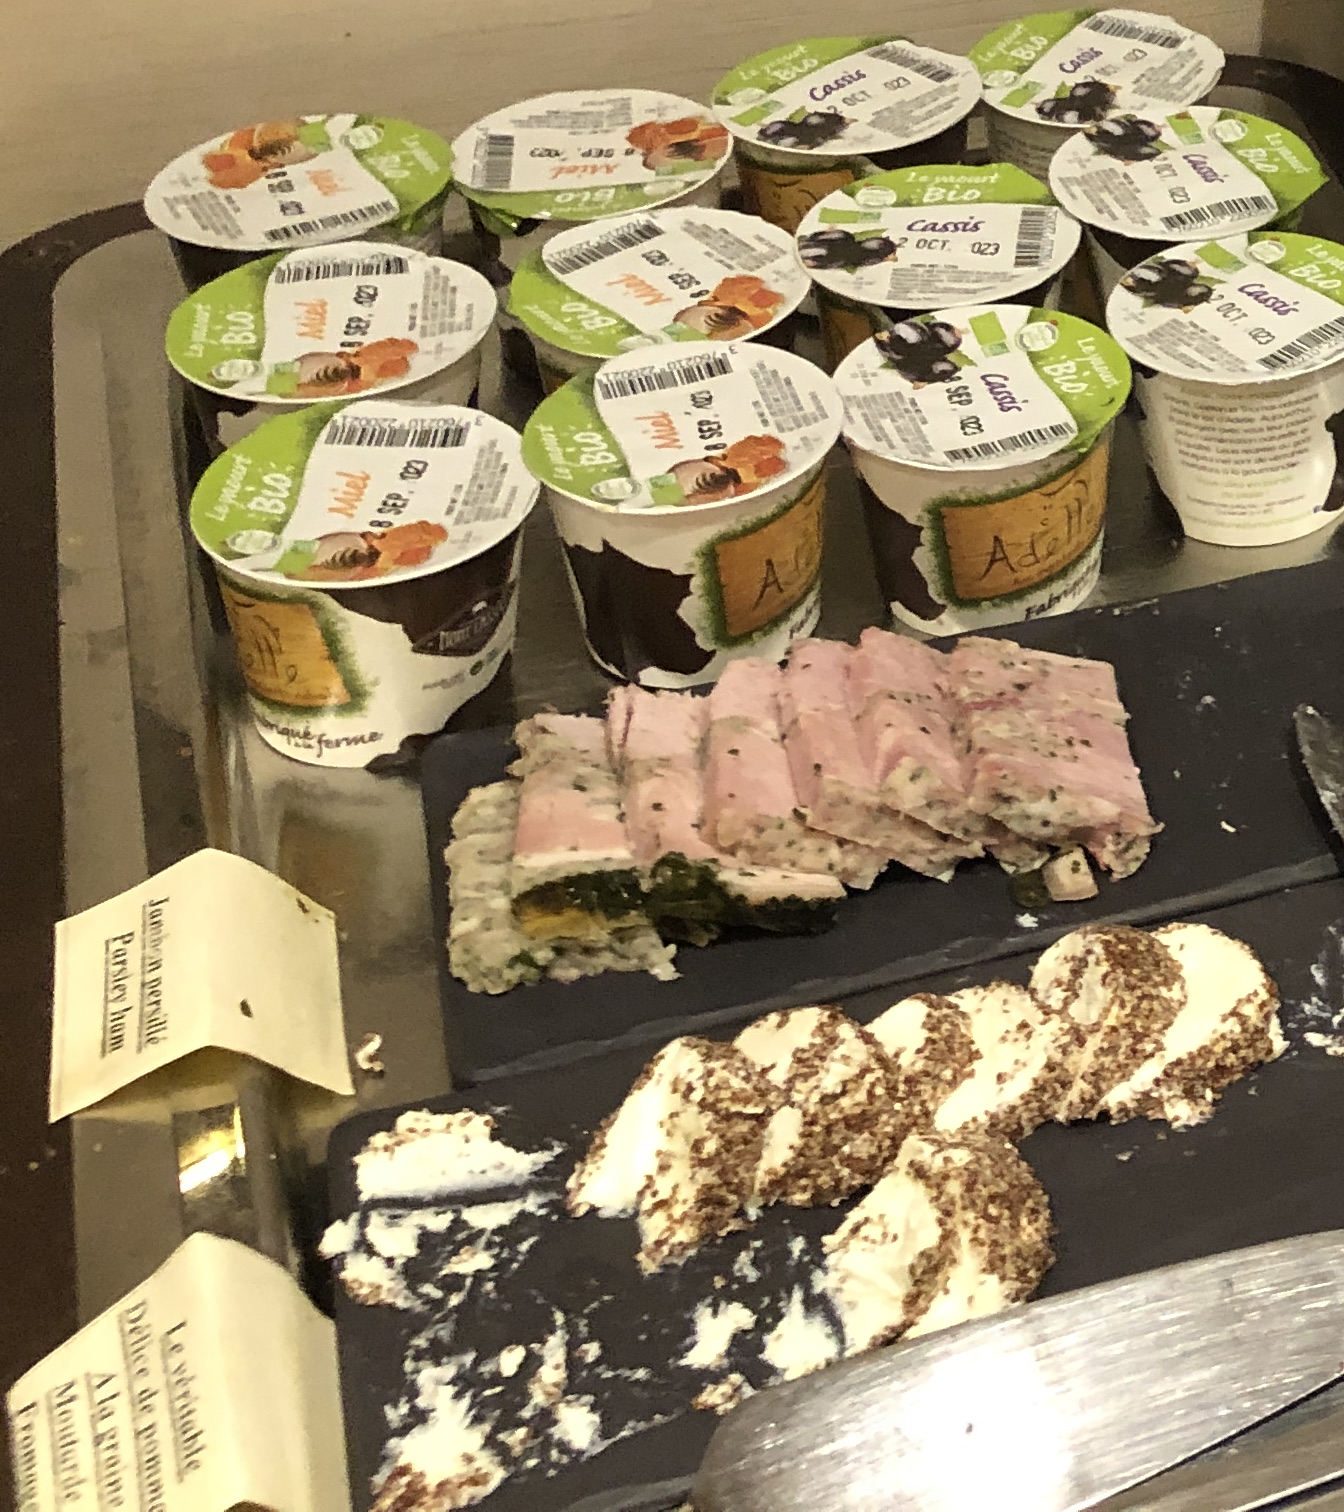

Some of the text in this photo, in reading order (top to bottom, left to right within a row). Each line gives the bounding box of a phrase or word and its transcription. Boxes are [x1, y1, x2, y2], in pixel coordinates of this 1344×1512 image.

[809, 68, 867, 102] Cassis
[922, 186, 981, 203] Bio
[906, 216, 985, 233] Cassis
[1237, 283, 1300, 316] Cassis
[980, 373, 1029, 414] Cassis
[634, 410, 684, 450] Miel
[246, 472, 293, 515] Bio
[327, 469, 372, 519] Miel
[108, 931, 135, 1055] Parsley ham
[143, 976, 169, 1046] persillé
